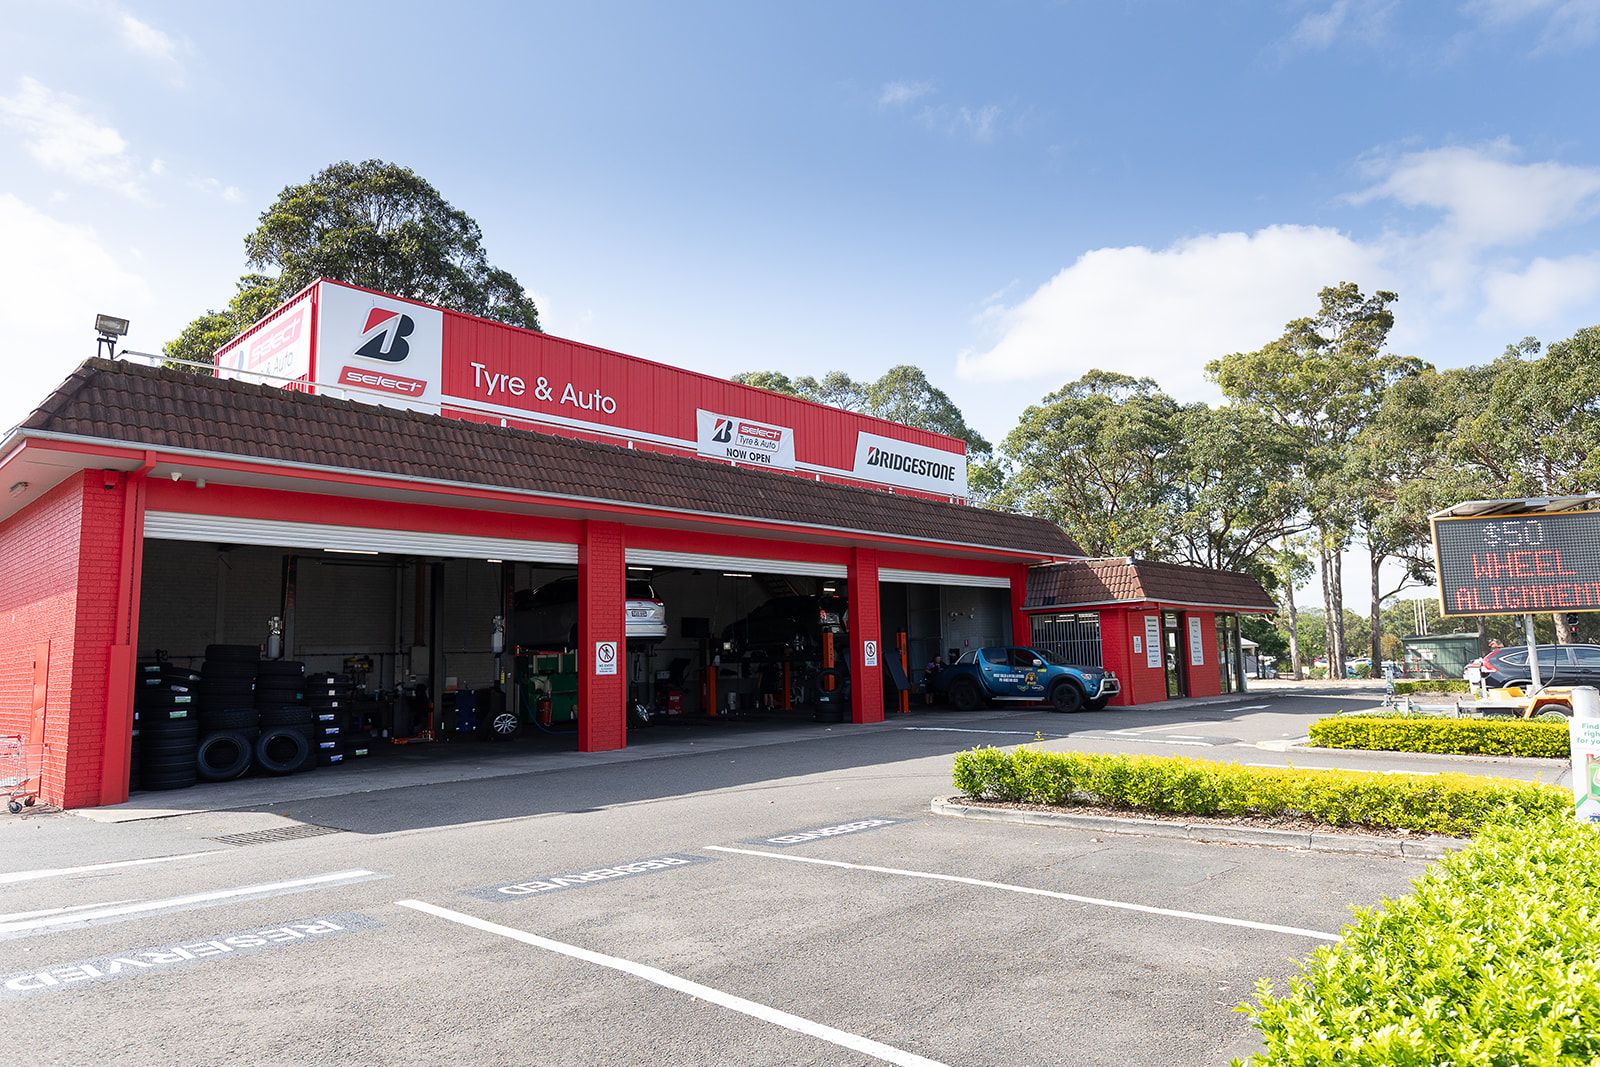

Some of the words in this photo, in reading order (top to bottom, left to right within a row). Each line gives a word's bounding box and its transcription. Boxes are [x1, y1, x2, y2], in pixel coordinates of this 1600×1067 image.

[251, 317, 301, 363] select
[273, 351, 294, 375] Auto
[346, 371, 422, 391] select
[469, 361, 525, 396] Tyre
[534, 376, 553, 402] &
[560, 382, 617, 414] Auto
[739, 435, 752, 445] Tyre
[760, 440, 777, 449] Auto
[740, 426, 780, 439] select
[726, 448, 747, 460] NOW
[749, 452, 771, 463] OPEN
[867, 446, 956, 482] BRIDGESTONE
[1482, 519, 1544, 547] $50
[1472, 549, 1577, 579] WHEEL
[1456, 582, 1600, 611] ALIGNMENT
[1581, 722, 1599, 730] Find
[767, 819, 896, 844] RESERVED
[497, 857, 691, 895] RESERVED
[4, 919, 344, 991] RESERVED
